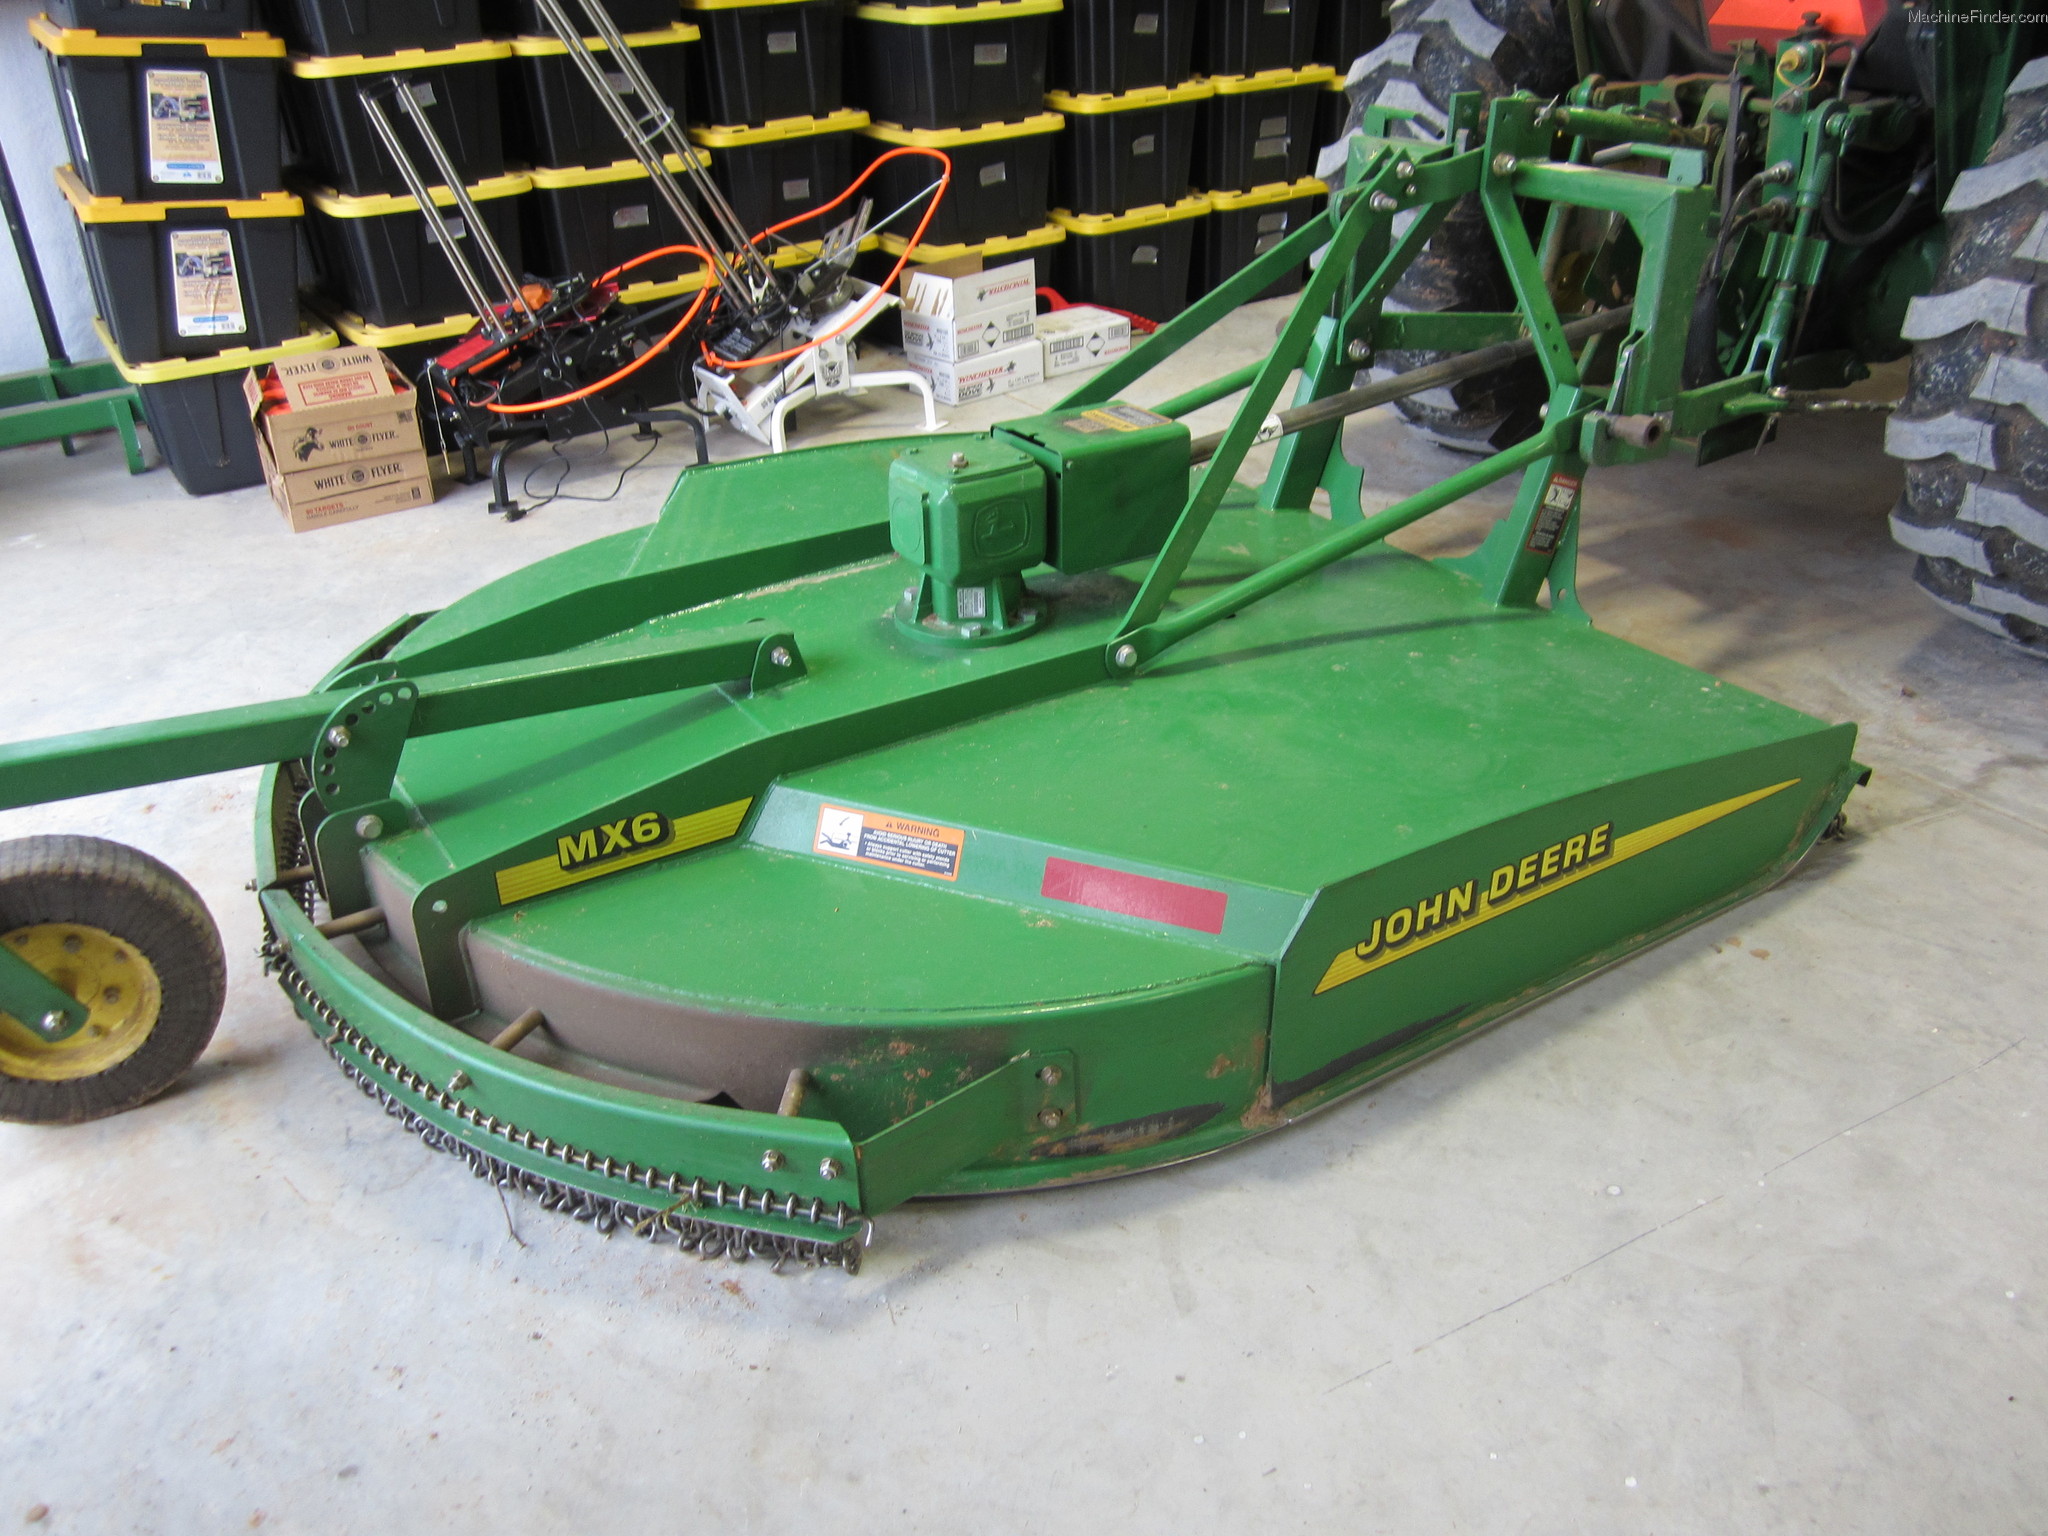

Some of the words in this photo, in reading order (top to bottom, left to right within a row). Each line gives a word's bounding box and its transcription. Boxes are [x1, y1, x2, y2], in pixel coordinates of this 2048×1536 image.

[341, 353, 373, 367] WHITE
[958, 366, 1004, 384] WINCHESTER
[328, 438, 353, 449] WHITE
[313, 475, 346, 491] WHITE
[896, 822, 940, 837] WARNING
[557, 810, 663, 868] MX6
[877, 835, 905, 847] ACCIDENTAL
[937, 846, 956, 857] CUTTER
[887, 831, 907, 842] SERIOUS
[907, 835, 924, 845] INJURY
[931, 840, 948, 849] DEATH
[1355, 879, 1475, 957] JOHN
[1487, 821, 1612, 903] DEERE
